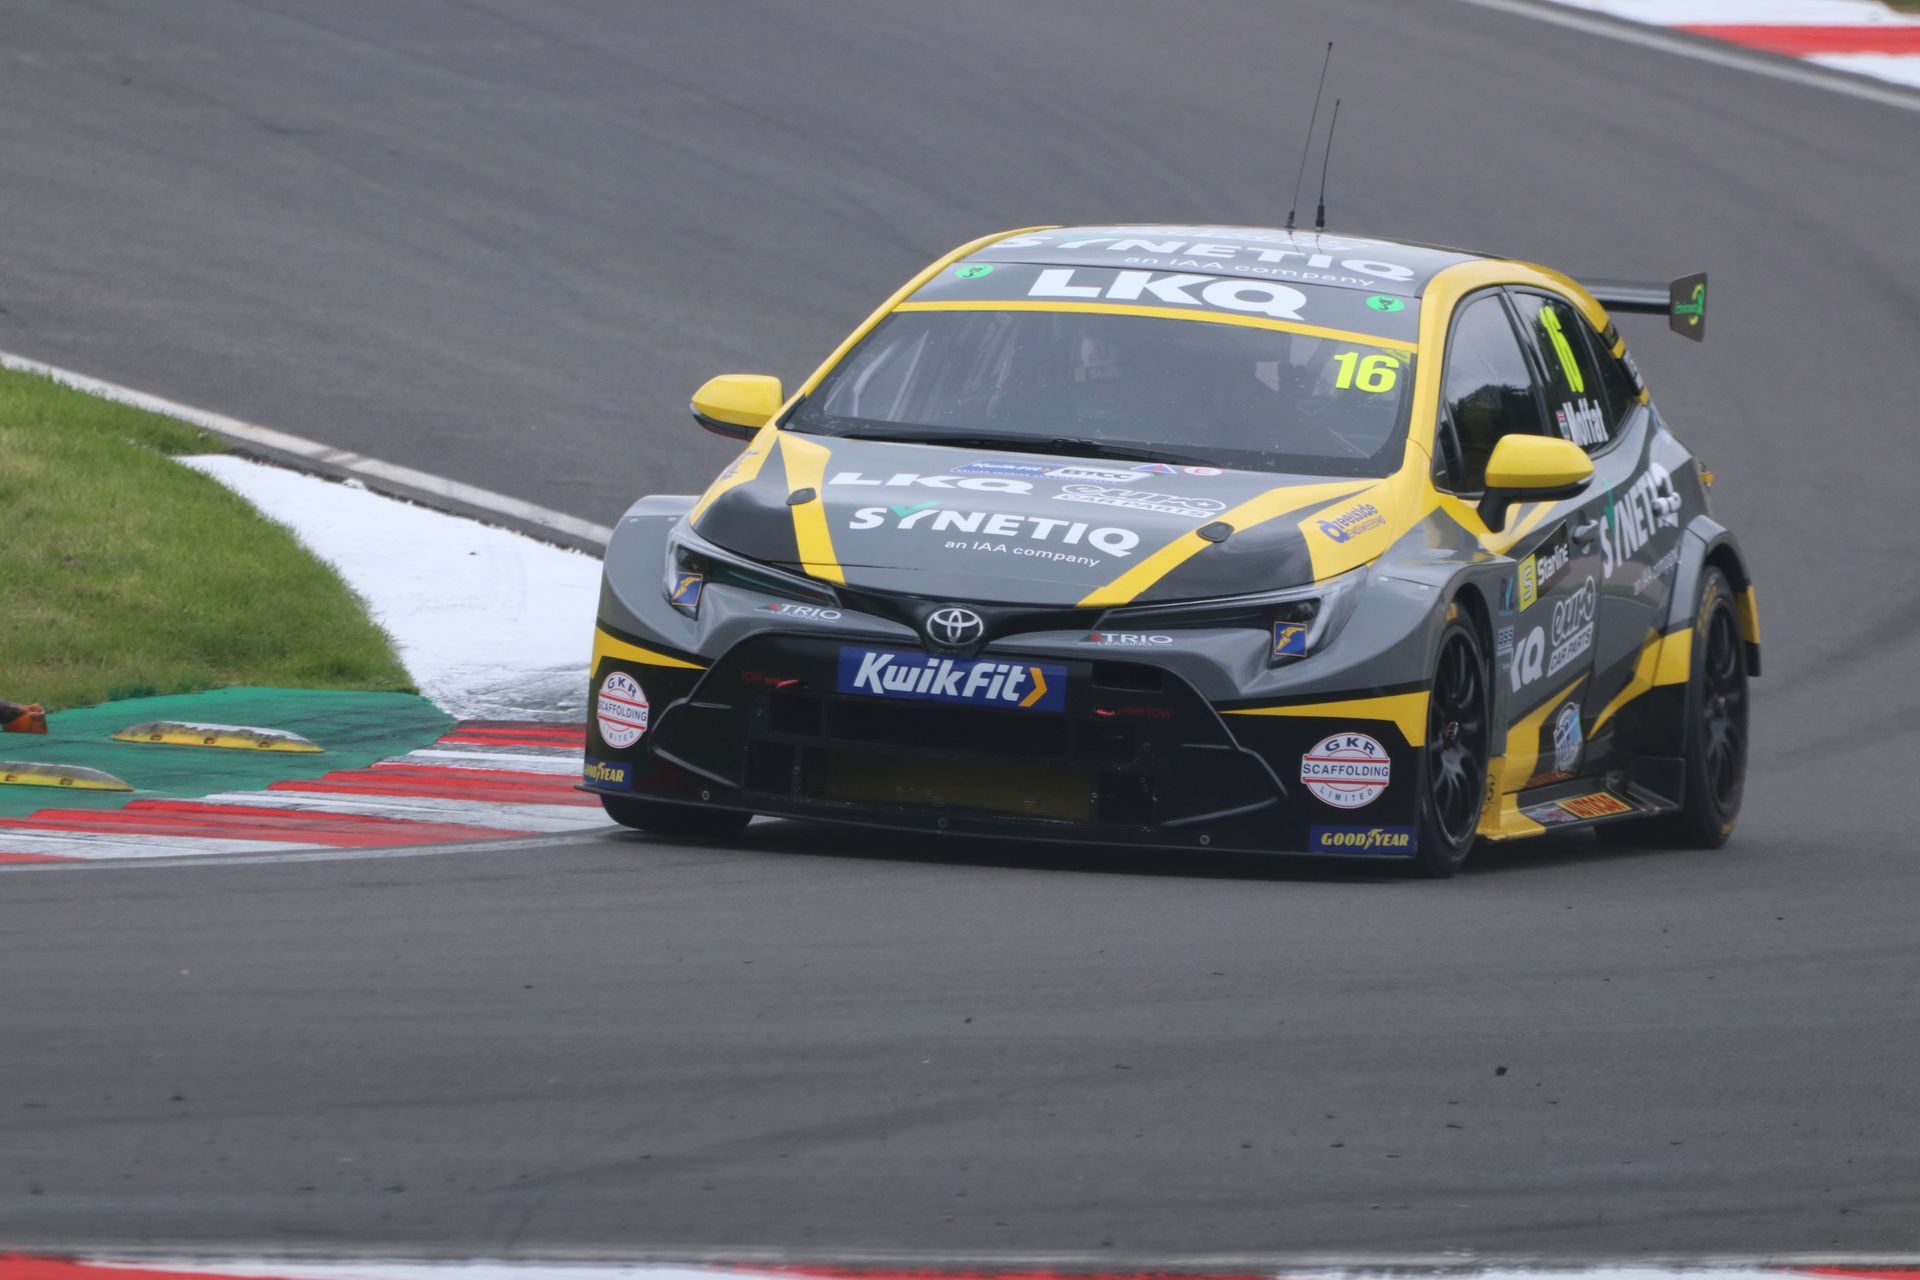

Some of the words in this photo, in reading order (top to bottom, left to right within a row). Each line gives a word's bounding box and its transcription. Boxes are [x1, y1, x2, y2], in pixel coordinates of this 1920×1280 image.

[989, 235, 1414, 282] SYNETIQ
[1124, 255, 1157, 264] an
[1170, 257, 1223, 269] IAA
[1234, 264, 1377, 287] company
[1028, 269, 1307, 321] LKQ
[1333, 351, 1400, 394] 16
[828, 472, 1034, 495] LKQ
[849, 502, 1140, 558] SYNETIQ
[944, 541, 968, 551] an
[973, 540, 1008, 554] IAA
[1013, 546, 1100, 568] company
[781, 604, 841, 620] TRIO
[1101, 633, 1173, 644] TRIO
[607, 676, 637, 698] GKR
[598, 700, 647, 722] SCAFFOLDING
[1324, 736, 1376, 755] GKR
[1303, 763, 1389, 777] SCAFFOLDING
[1319, 785, 1374, 803] LIMITED
[1321, 828, 1409, 850] GOODYEAR
